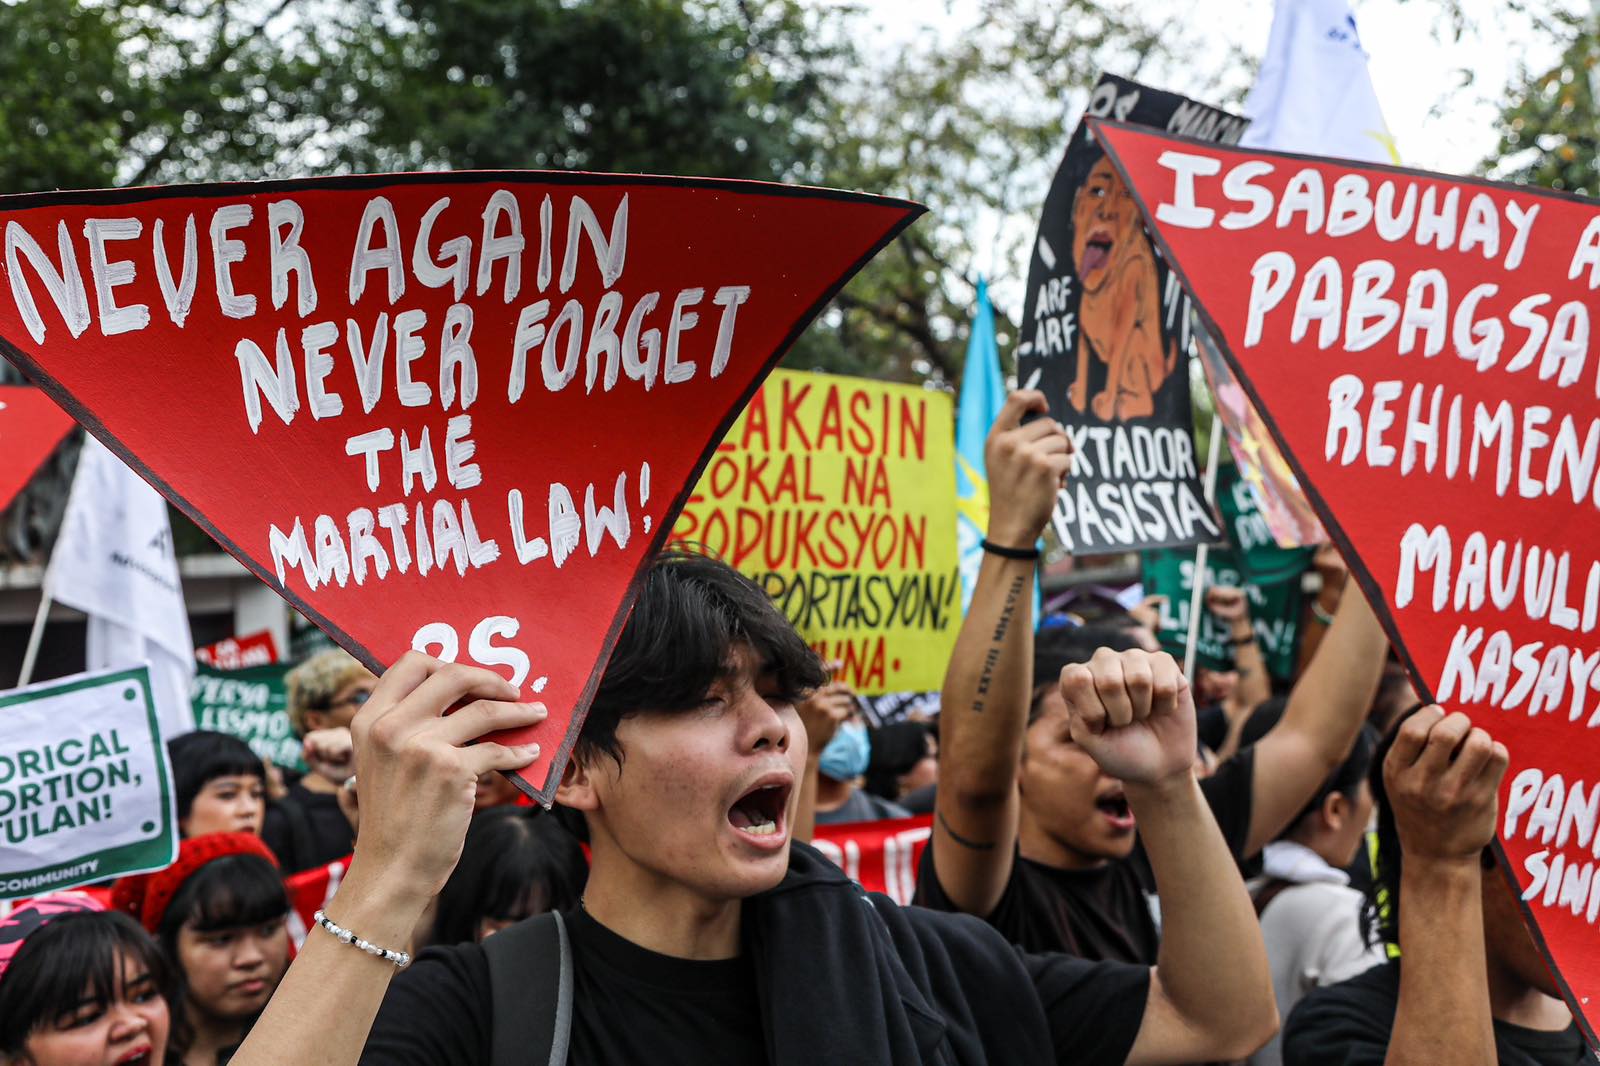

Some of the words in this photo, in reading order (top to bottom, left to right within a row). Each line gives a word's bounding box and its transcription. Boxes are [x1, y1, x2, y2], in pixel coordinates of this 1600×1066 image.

[1155, 150, 1541, 270] ISABUHAY
[4, 199, 318, 345] NEVER
[348, 189, 629, 305] AGAIN
[1034, 275, 1072, 321] ARF
[234, 302, 478, 435] NEVER
[508, 286, 752, 403] FORGET
[1034, 313, 1077, 357] ARF
[1244, 250, 1600, 400] PABAGSA
[345, 414, 482, 496] THE
[717, 378, 926, 461] AKASIN
[1056, 422, 1197, 480] KTADOR
[1325, 374, 1600, 510] REHIMEN
[687, 453, 824, 508] OKAL
[843, 455, 891, 509] NA
[1052, 481, 1220, 550] PASISTA
[268, 498, 501, 591] MARTIAL
[508, 461, 652, 568] LAW!
[754, 566, 959, 632] PORTASYON!
[0, 794, 113, 844] ULAN!
[1503, 767, 1600, 859] PAN
